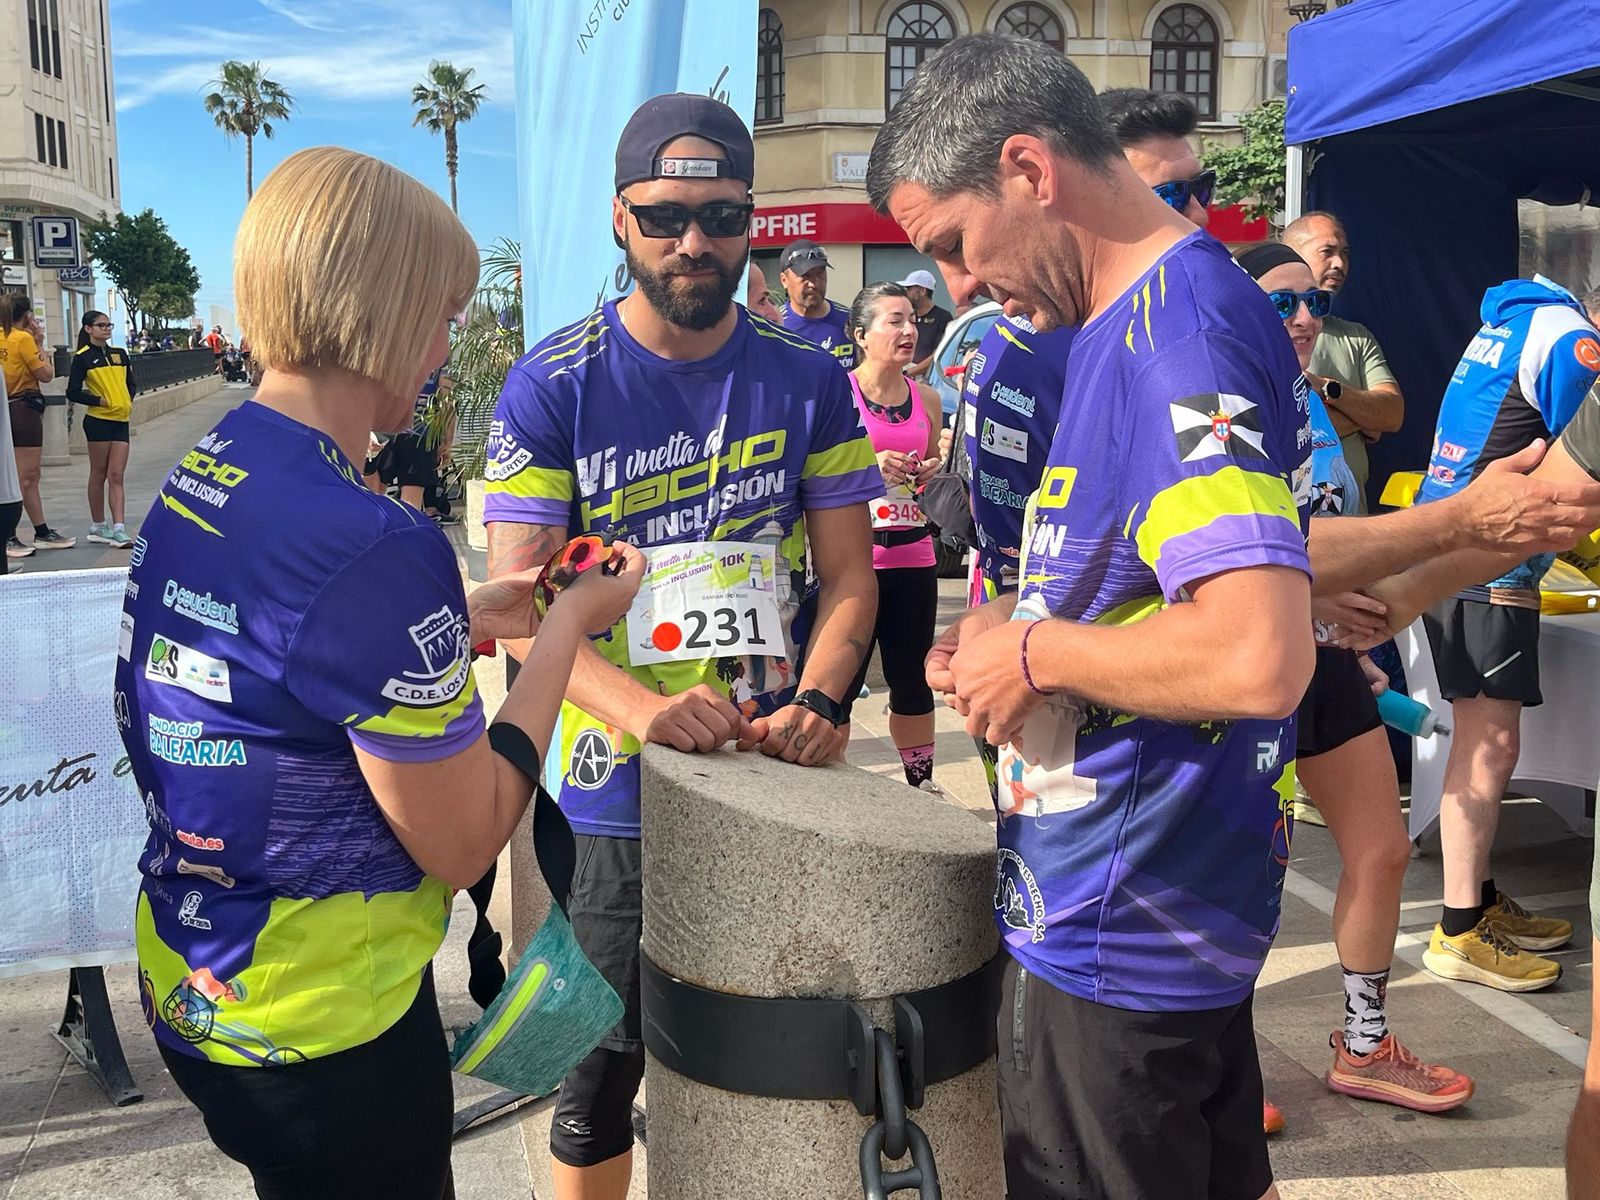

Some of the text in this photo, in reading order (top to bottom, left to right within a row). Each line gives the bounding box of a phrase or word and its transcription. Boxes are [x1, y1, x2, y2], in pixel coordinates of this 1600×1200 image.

[682, 161, 712, 174] Yankees
[43, 222, 67, 247] P
[750, 213, 816, 238] PFRE
[61, 267, 89, 279] ABC
[646, 469, 786, 543] INCLUSIÓN
[888, 504, 919, 522] 348
[719, 552, 746, 568] 10K
[683, 607, 766, 649] 231
[393, 677, 461, 700] C.D.E. LOS
[150, 728, 247, 766] BALEARIA
